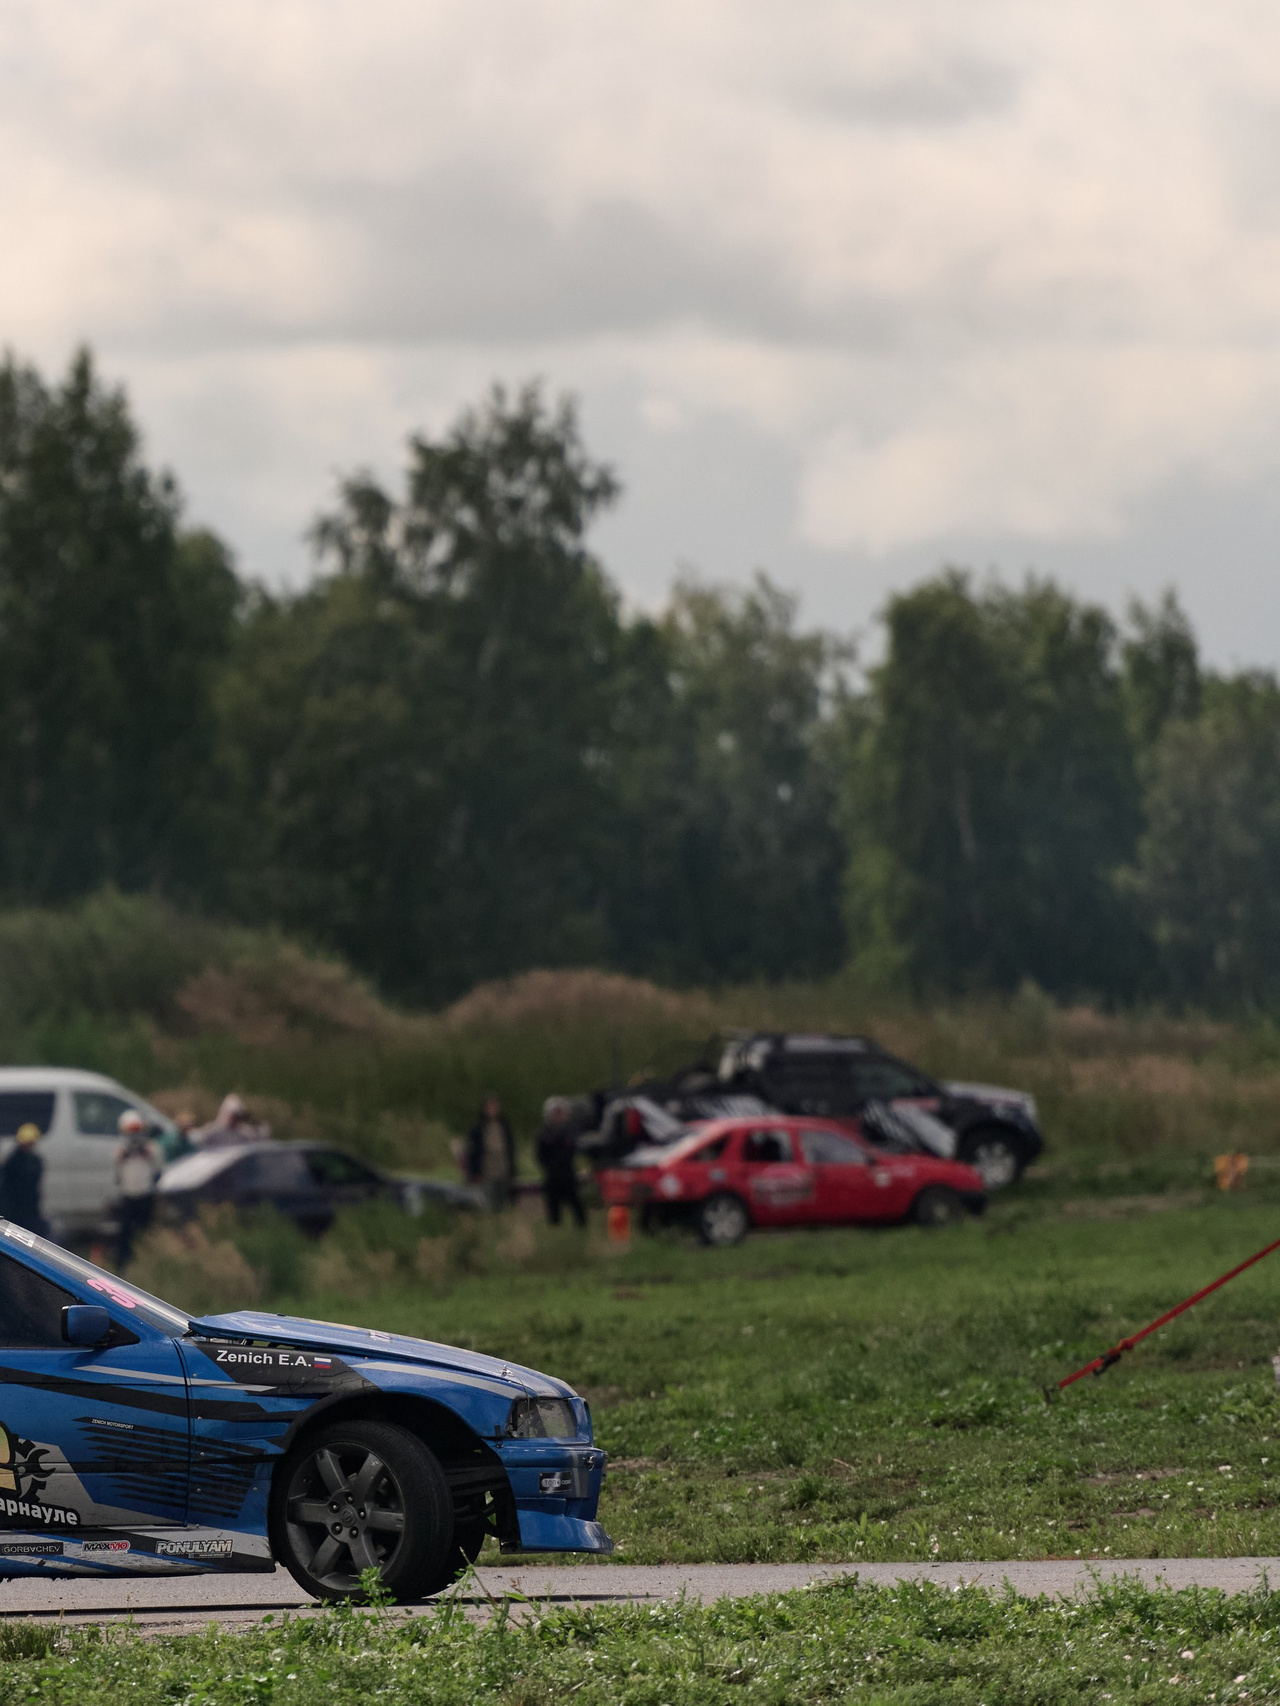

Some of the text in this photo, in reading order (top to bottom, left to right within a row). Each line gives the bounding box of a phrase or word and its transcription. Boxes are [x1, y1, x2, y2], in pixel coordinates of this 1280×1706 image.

[217, 1350, 311, 1367] Zenich E.A.
[157, 1541, 232, 1553] PONULYAM
